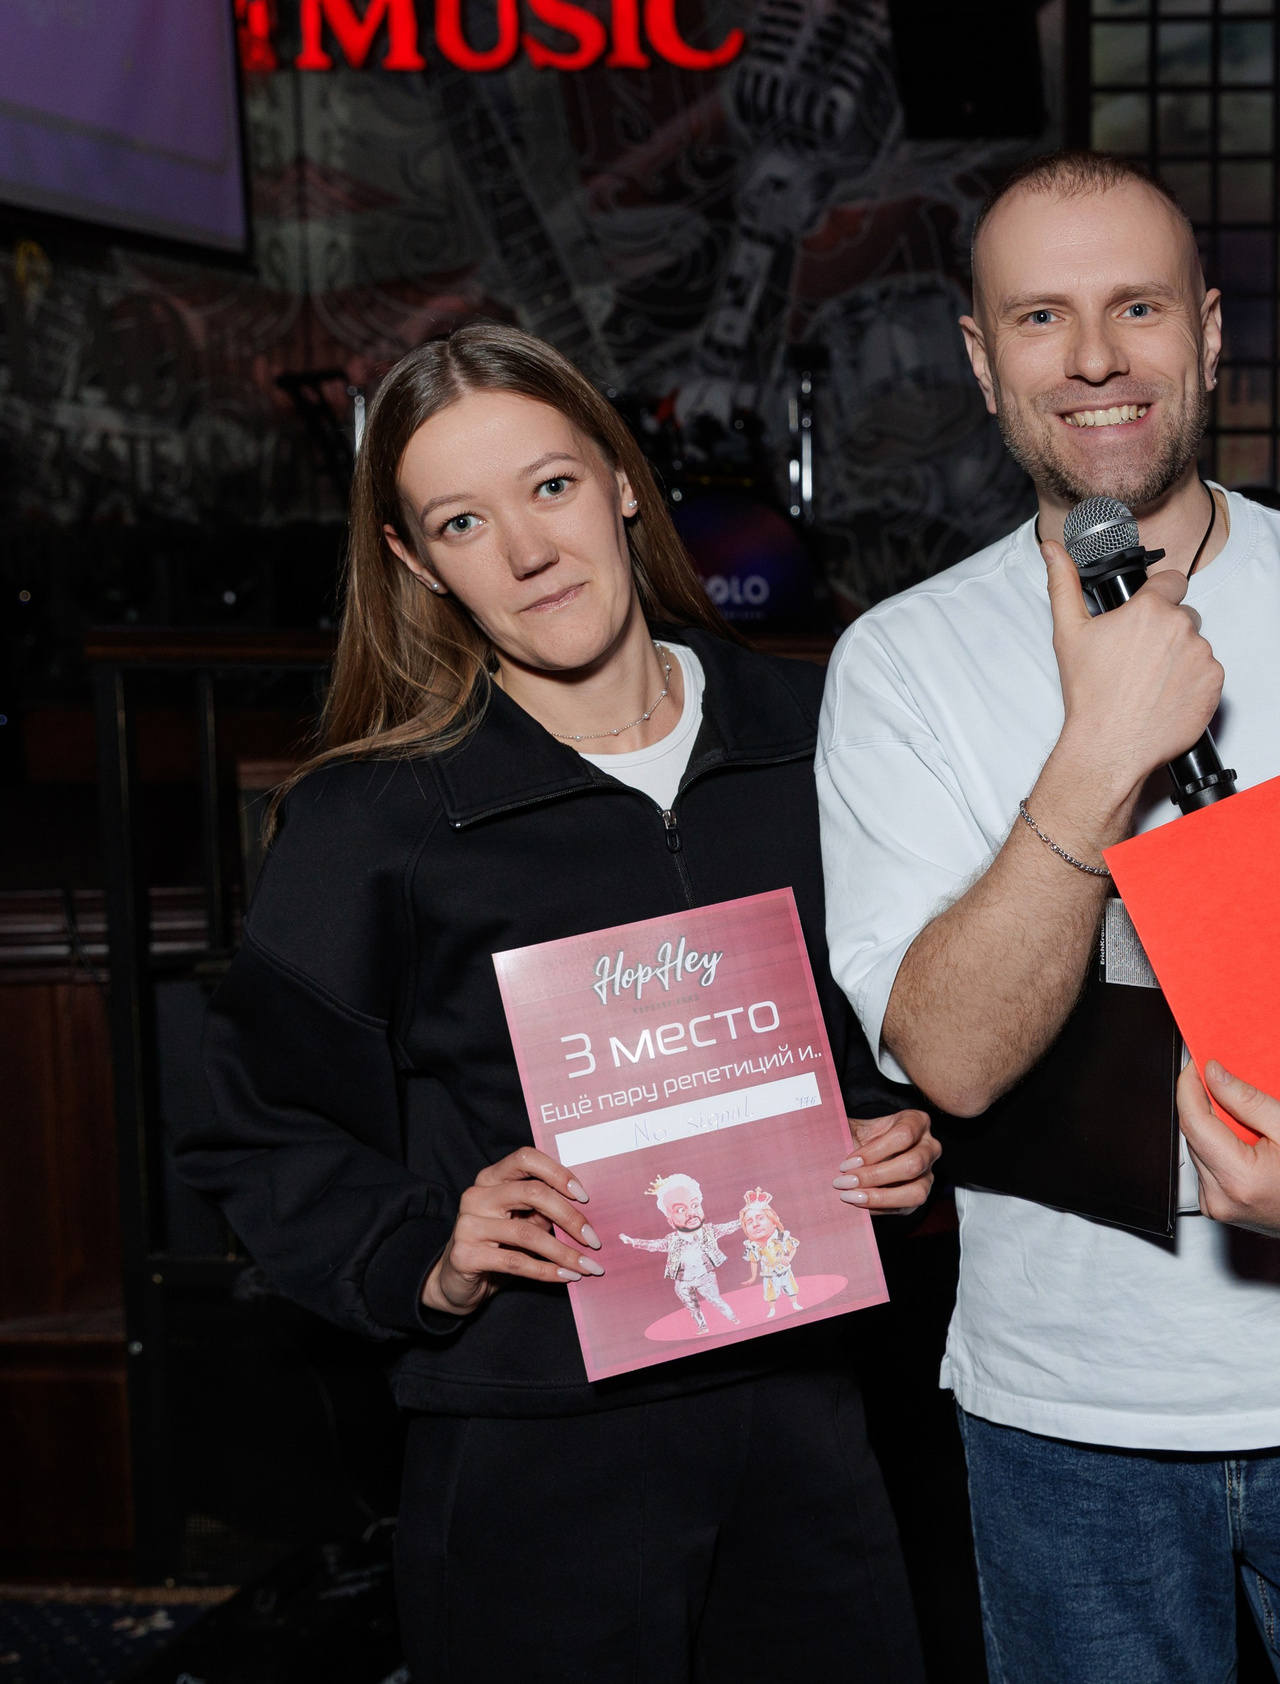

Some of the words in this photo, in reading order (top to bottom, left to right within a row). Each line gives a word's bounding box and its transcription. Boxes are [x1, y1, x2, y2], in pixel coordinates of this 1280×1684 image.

[295, 0, 745, 71] MUSIC
[700, 574, 770, 606] OLO
[592, 936, 723, 1005] HopHey
[540, 1095, 593, 1124] Ещё
[598, 1083, 658, 1111] пару
[663, 1044, 794, 1098] репетиций
[560, 1033, 596, 1079] 3
[633, 1118, 667, 1148] No
